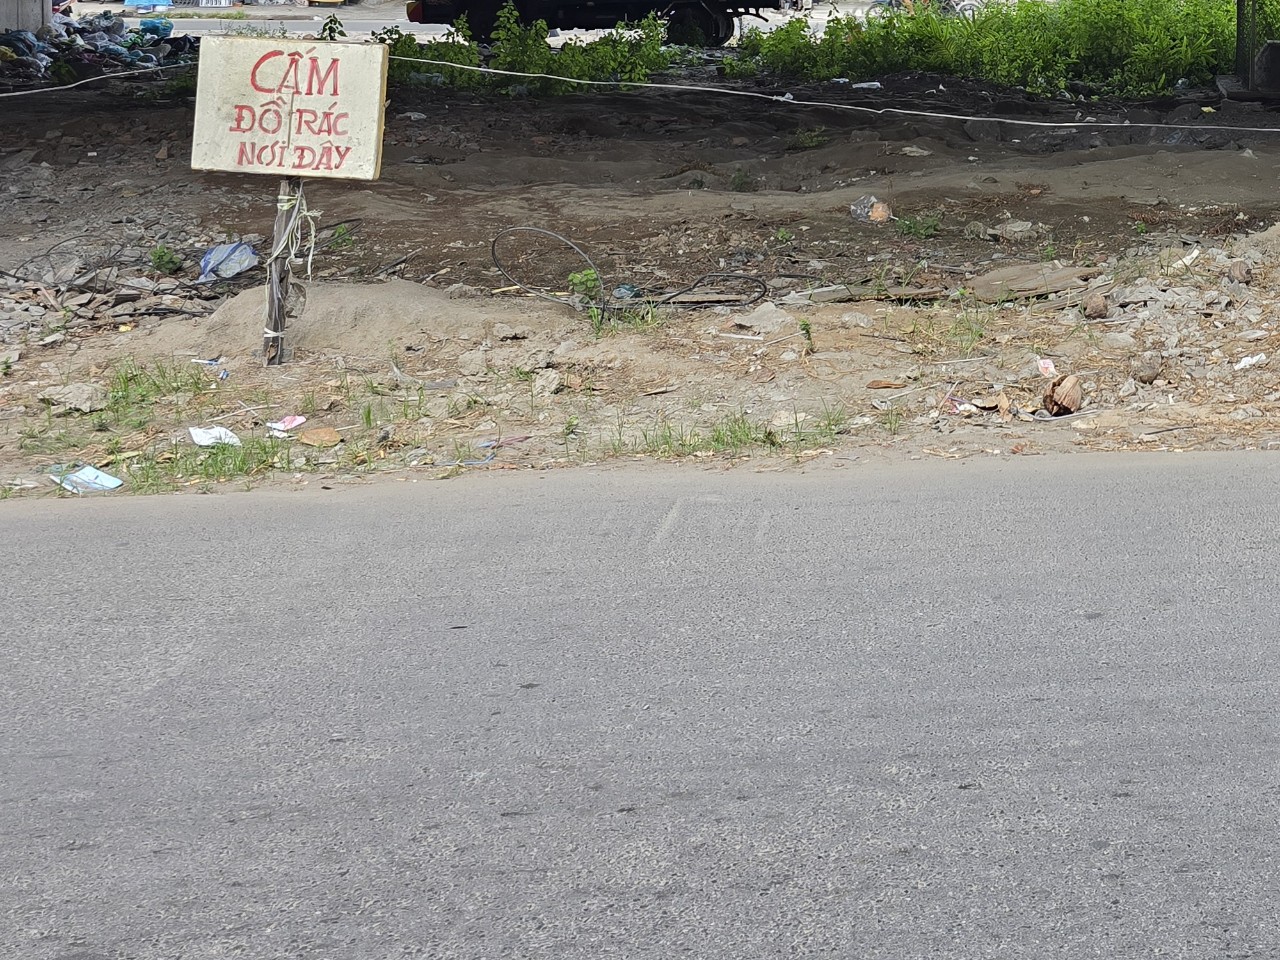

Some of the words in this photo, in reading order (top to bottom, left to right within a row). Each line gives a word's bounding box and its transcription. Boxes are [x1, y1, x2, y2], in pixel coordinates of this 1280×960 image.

[250, 46, 340, 96] CẤM
[296, 101, 350, 137] RÁC
[291, 140, 352, 170] ĐÂY
